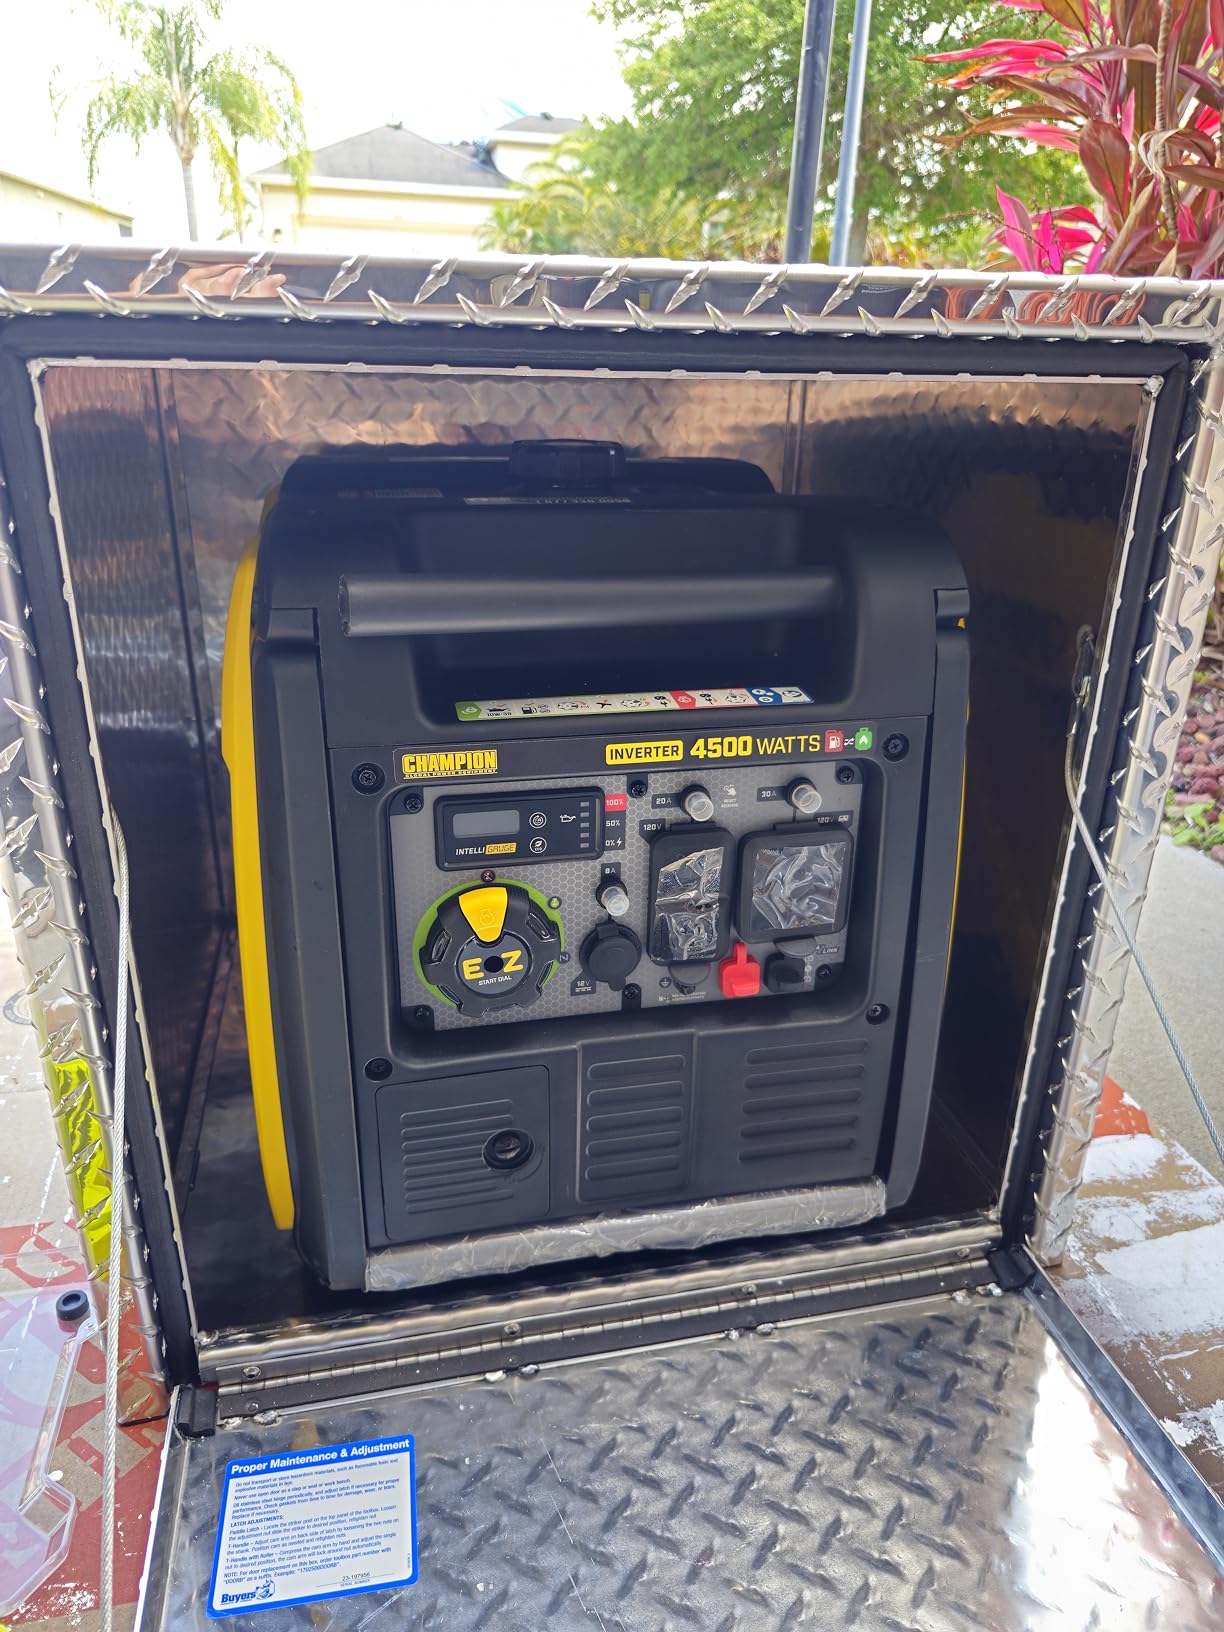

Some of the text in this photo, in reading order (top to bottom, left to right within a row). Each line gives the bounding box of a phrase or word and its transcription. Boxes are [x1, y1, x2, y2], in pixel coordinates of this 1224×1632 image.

[610, 734, 820, 760] INVERTER 4500 WATTS
[403, 750, 497, 774] CHAMPION
[816, 815, 834, 824] 120V
[643, 823, 662, 832] 120V
[478, 978, 497, 986] START
[231, 1439, 410, 1475] Proper Maintenance & Adjustment
[247, 1515, 284, 1524] ADJUSTMENTS:
[261, 1563, 290, 1573] replacement
[342, 1572, 370, 1582] 23-197956
[221, 1591, 256, 1604] Buyers
